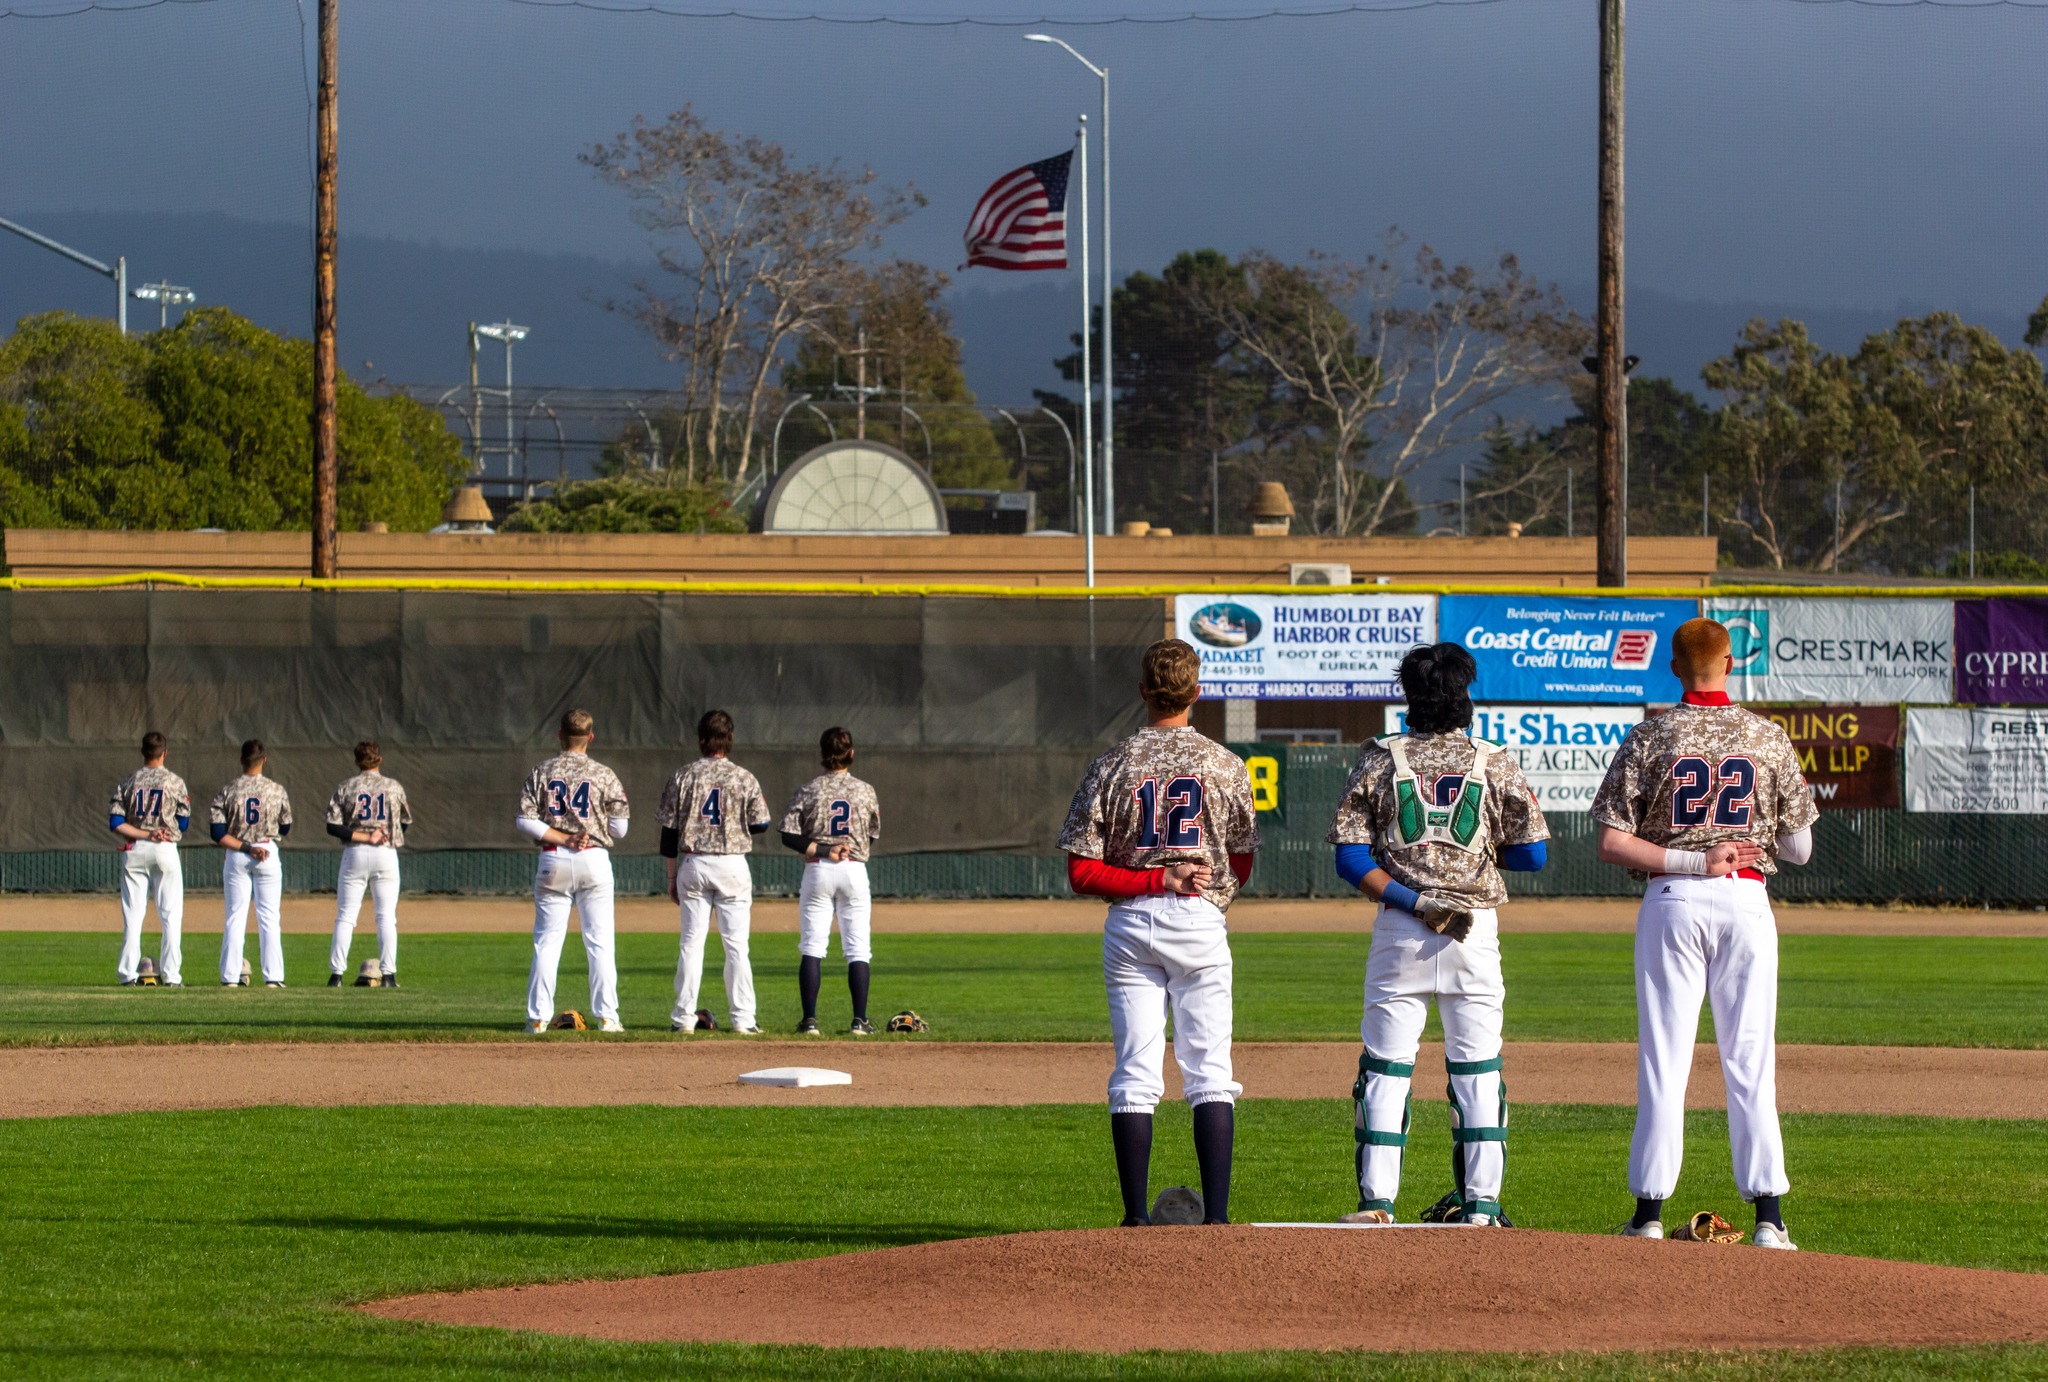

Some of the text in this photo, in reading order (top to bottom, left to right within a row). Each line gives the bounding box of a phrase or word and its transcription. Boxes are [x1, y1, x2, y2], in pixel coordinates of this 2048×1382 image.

[1273, 606, 1425, 623] HUMBOLDT BAY
[1506, 608, 1561, 623] Belonging
[1563, 609, 1595, 621] Never
[1598, 610, 1619, 621] Felt
[1273, 626, 1425, 643] HARBOR CRUISE
[1465, 626, 1613, 652] Coast Central
[1197, 646, 1265, 663] ADAKET
[1277, 650, 1318, 659] FOOT
[1322, 650, 1342, 659] OF
[1512, 651, 1608, 669] Credit Union
[1775, 637, 1949, 663] CRESTMARK
[1202, 665, 1265, 676] 7-445-1910
[1319, 662, 1378, 671] EUREKA
[1865, 666, 1948, 679] MILLWORK
[1225, 683, 1260, 697] CRUISE
[1265, 683, 1306, 697] HARBOR
[1307, 683, 1347, 697] CRUISES
[1352, 684, 1392, 697] PRIVATE
[1967, 676, 2008, 688] FINE
[1536, 748, 1617, 771] AGENC
[1829, 745, 1871, 772] LLP
[547, 778, 592, 820] 34
[1670, 755, 1757, 828] 22
[135, 789, 164, 818] 17
[244, 796, 261, 826] 6
[357, 793, 386, 821] 31
[701, 786, 723, 827] 4
[1133, 775, 1205, 850] 12
[1952, 796, 2020, 811] 822-7500
[828, 799, 852, 837] 2
